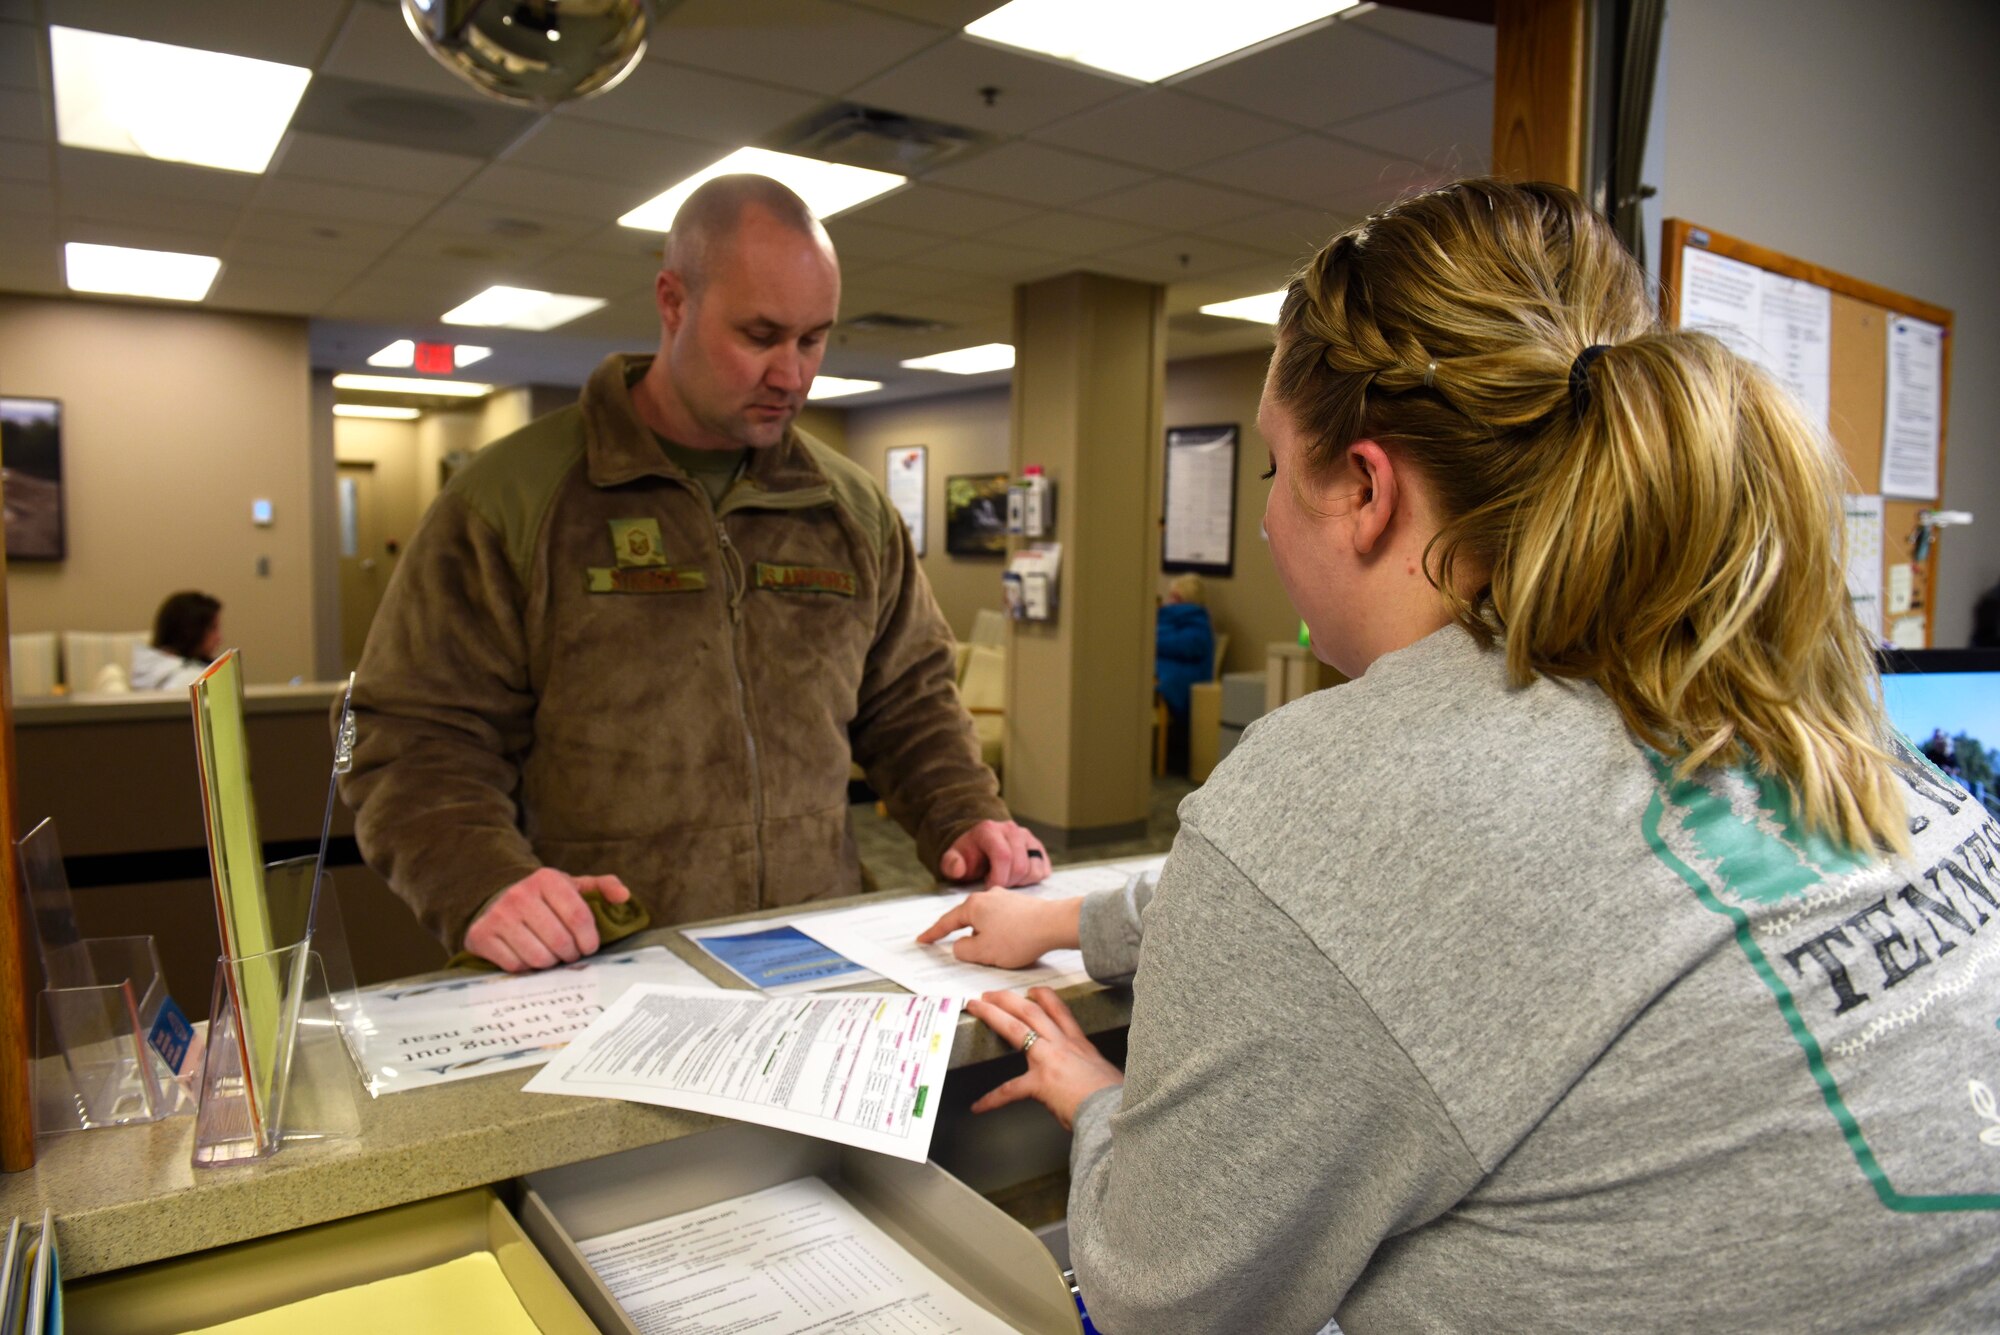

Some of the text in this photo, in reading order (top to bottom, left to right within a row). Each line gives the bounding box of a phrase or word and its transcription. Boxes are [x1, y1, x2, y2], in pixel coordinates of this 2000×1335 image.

[397, 1004, 606, 1046] US in the near
[491, 992, 586, 1018] future?
[404, 1021, 590, 1062] traveling out
